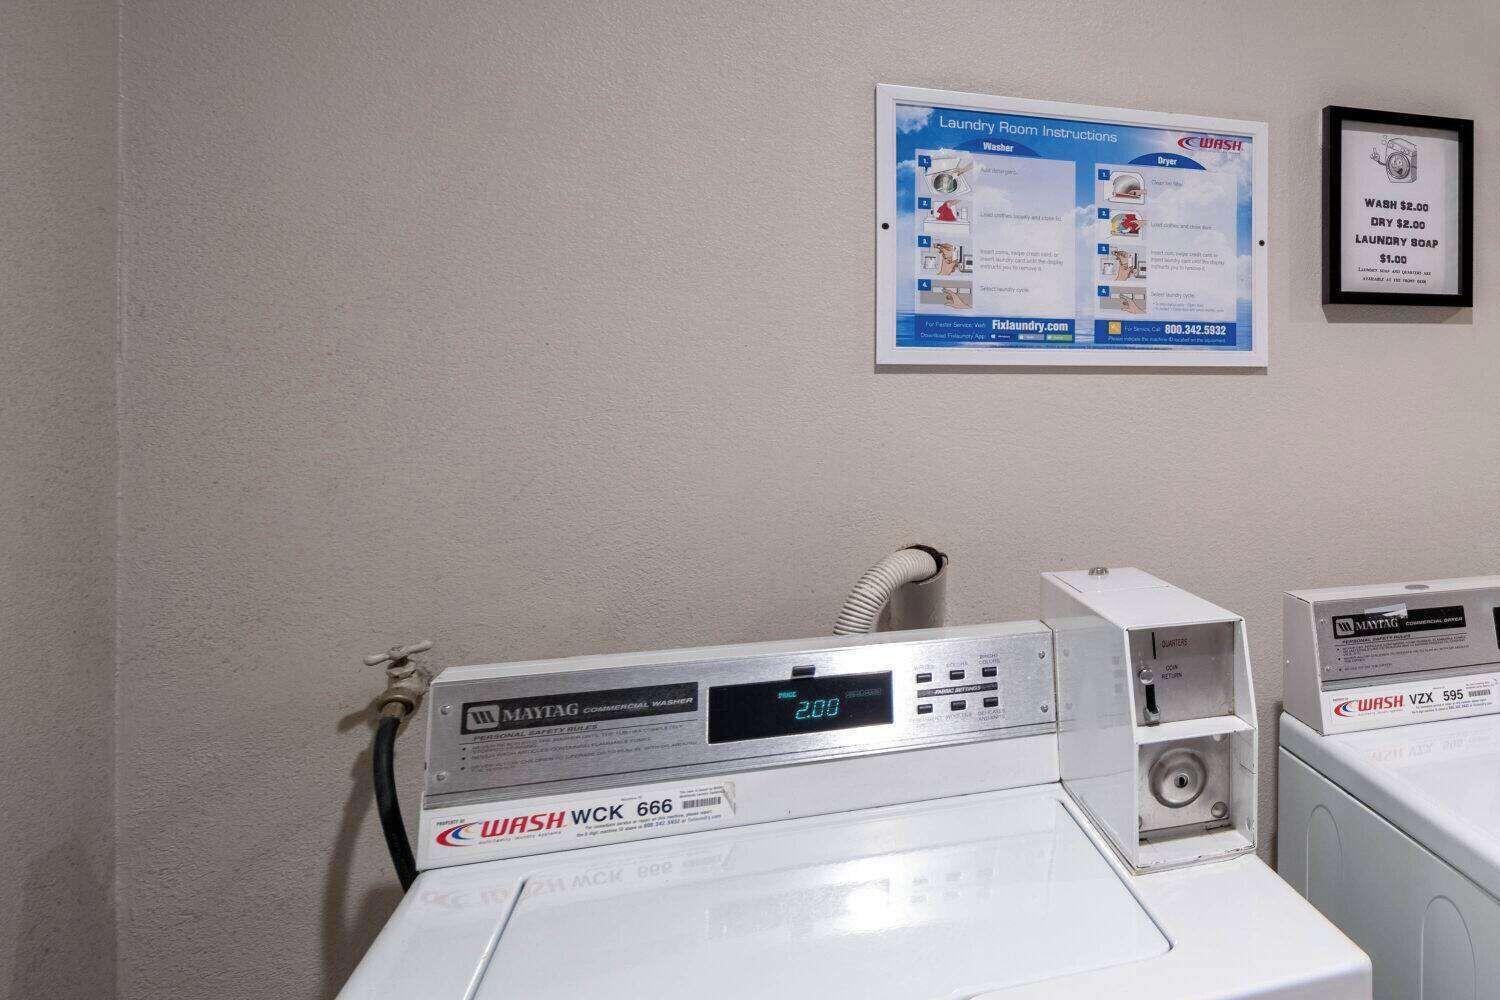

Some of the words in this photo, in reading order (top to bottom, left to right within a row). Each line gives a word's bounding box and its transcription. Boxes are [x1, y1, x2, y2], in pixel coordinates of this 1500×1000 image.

[940, 116, 994, 134] Laundry
[1000, 122, 1038, 135] Room
[1043, 126, 1117, 143] Instructions
[983, 142, 1014, 152] Washer
[1200, 137, 1242, 151] WASH
[1158, 156, 1177, 166] Dryer
[1365, 198, 1397, 209] WASH
[1401, 201, 1428, 212] $2.00
[1371, 217, 1393, 227] DRY
[1397, 218, 1425, 229] $2.00
[1356, 234, 1407, 246] LAUNDRY
[1411, 239, 1438, 248] SOAP
[1380, 254, 1407, 264] $1.00
[992, 320, 1068, 333] Fixlaundry.com
[1165, 324, 1226, 335] 800.342.5932
[1355, 618, 1398, 631] MAYTAG
[1406, 618, 1442, 626] COMMERCIAL
[1161, 638, 1188, 649] QUARTERS
[1166, 664, 1178, 672] COIN
[1161, 671, 1182, 680] RETURN
[778, 691, 797, 699] PRICE
[1358, 695, 1404, 712] WASH
[1409, 691, 1433, 705] VZX
[1443, 689, 1464, 702] 595
[502, 702, 580, 723] MAYTAG
[583, 702, 649, 713] COMMERCIAL
[652, 697, 694, 707] WASHER
[794, 698, 841, 720] 2.00
[472, 730, 528, 742] PERSONAL
[530, 727, 565, 736] SAFETY
[566, 724, 598, 732] RULES
[481, 811, 566, 838] WASH
[571, 804, 624, 825] WCK
[637, 799, 673, 816] 666
